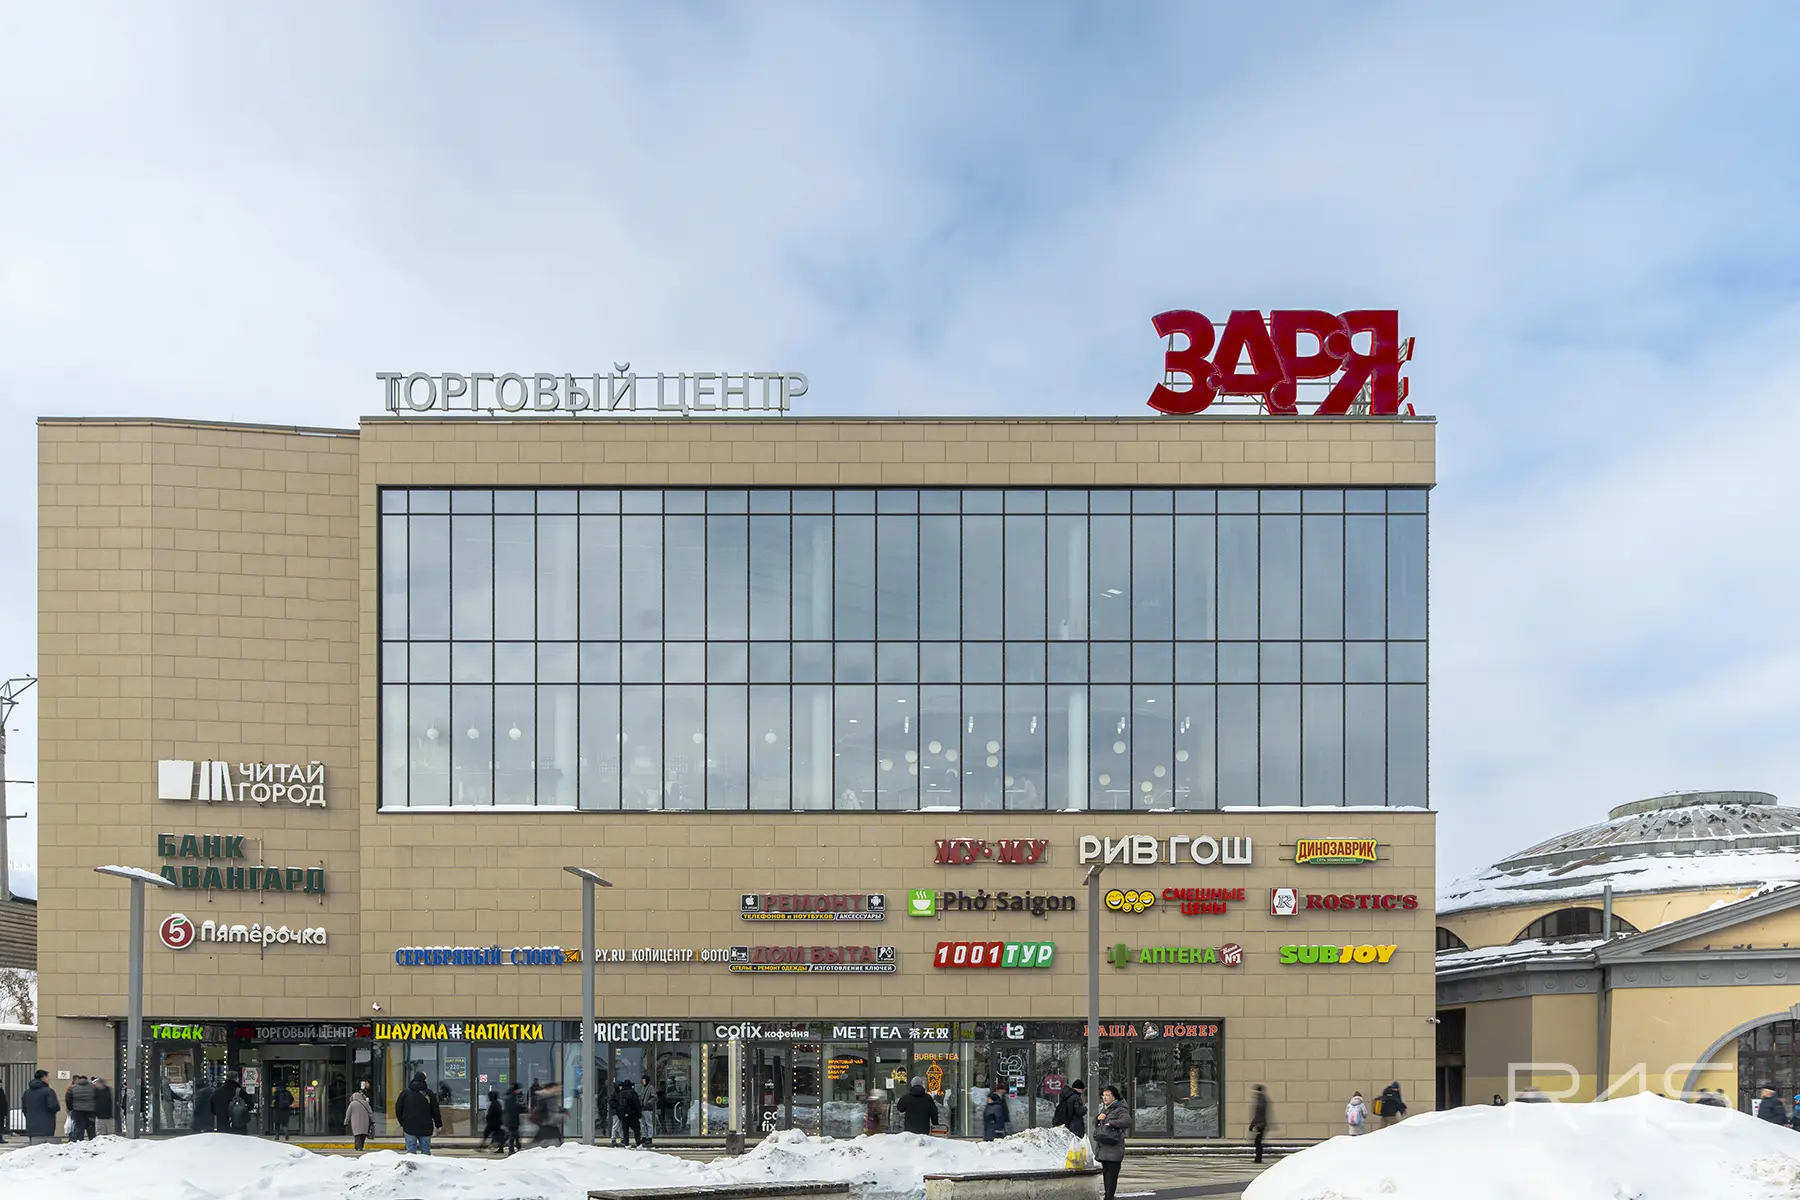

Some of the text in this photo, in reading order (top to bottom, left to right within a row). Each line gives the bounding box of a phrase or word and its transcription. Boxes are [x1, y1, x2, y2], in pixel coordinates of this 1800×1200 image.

[1146, 309, 1399, 416] ЗАРЯ
[376, 361, 809, 416] ТОРГОВЫЙ ЦЕНТР
[239, 761, 325, 784] ЧИТАЙ
[239, 782, 327, 807] ГОРОД
[158, 833, 245, 859] БАНК
[1079, 835, 1252, 865] РИВ ГОШ
[1298, 841, 1375, 861] ДИНОЗАВРИК
[158, 865, 326, 894] АВАНГАРД
[763, 894, 863, 912] РЕМОНТ
[1162, 887, 1246, 901] СМЕШНЫЕ
[1305, 894, 1419, 909] ROSTIC'S
[996, 891, 1076, 916] Saigon
[1181, 902, 1227, 916] ЦЕНЫ
[395, 944, 565, 966] СЕРЕБРЯНЫЙ СЛОНЪ
[632, 949, 693, 963] КОПИЦЕНТР
[701, 948, 729, 963] ФОТО
[751, 946, 874, 964] ДОМ БЫТА
[1139, 947, 1216, 964] АПТЕКА
[150, 1025, 203, 1040] ТАБАК
[256, 1025, 316, 1039] ТОРГОВЫЙ
[318, 1025, 354, 1040] ЦЕНТР
[631, 1022, 680, 1042] COFFEE
[716, 1022, 809, 1040] cofix кофейня
[832, 1026, 949, 1039] MET TEA 茶无双
[1006, 1022, 1025, 1039] t2
